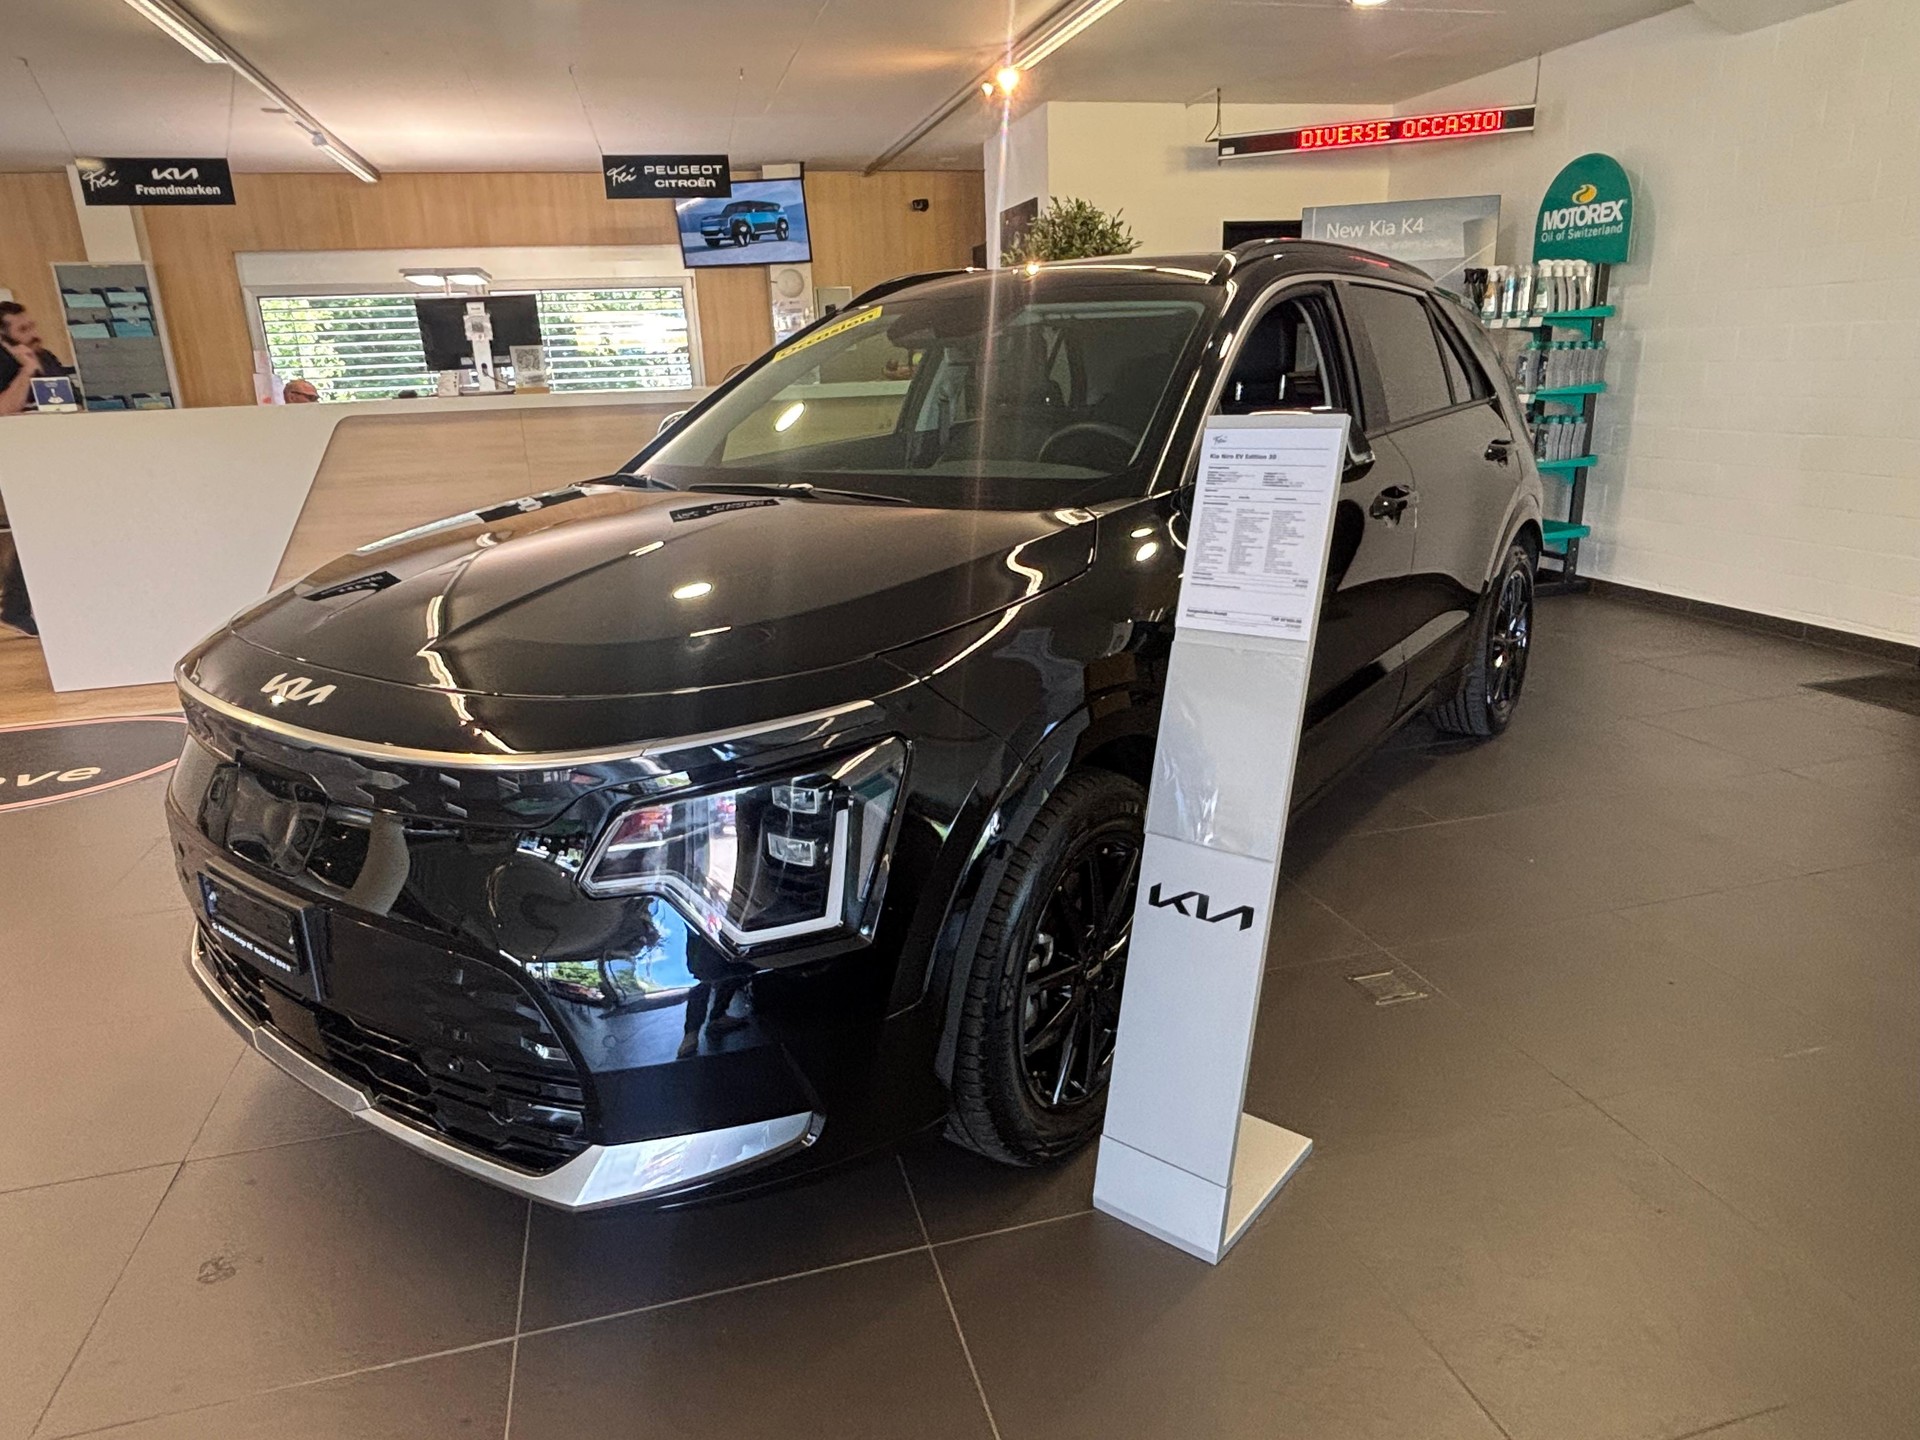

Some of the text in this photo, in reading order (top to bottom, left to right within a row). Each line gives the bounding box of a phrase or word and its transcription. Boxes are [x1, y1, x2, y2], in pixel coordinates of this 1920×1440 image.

[1301, 122, 1391, 147] DIVERSE
[82, 167, 120, 192] Frei
[606, 164, 638, 188] Frei
[643, 165, 723, 175] PEUGEOT
[135, 184, 221, 196] Fremdmarken
[654, 176, 716, 188] CITROËN
[1542, 199, 1625, 231] MOTOREX
[1326, 217, 1424, 239] New Kia K4
[1541, 222, 1624, 242] Oil of Switzerland
[0, 767, 101, 787] ve
